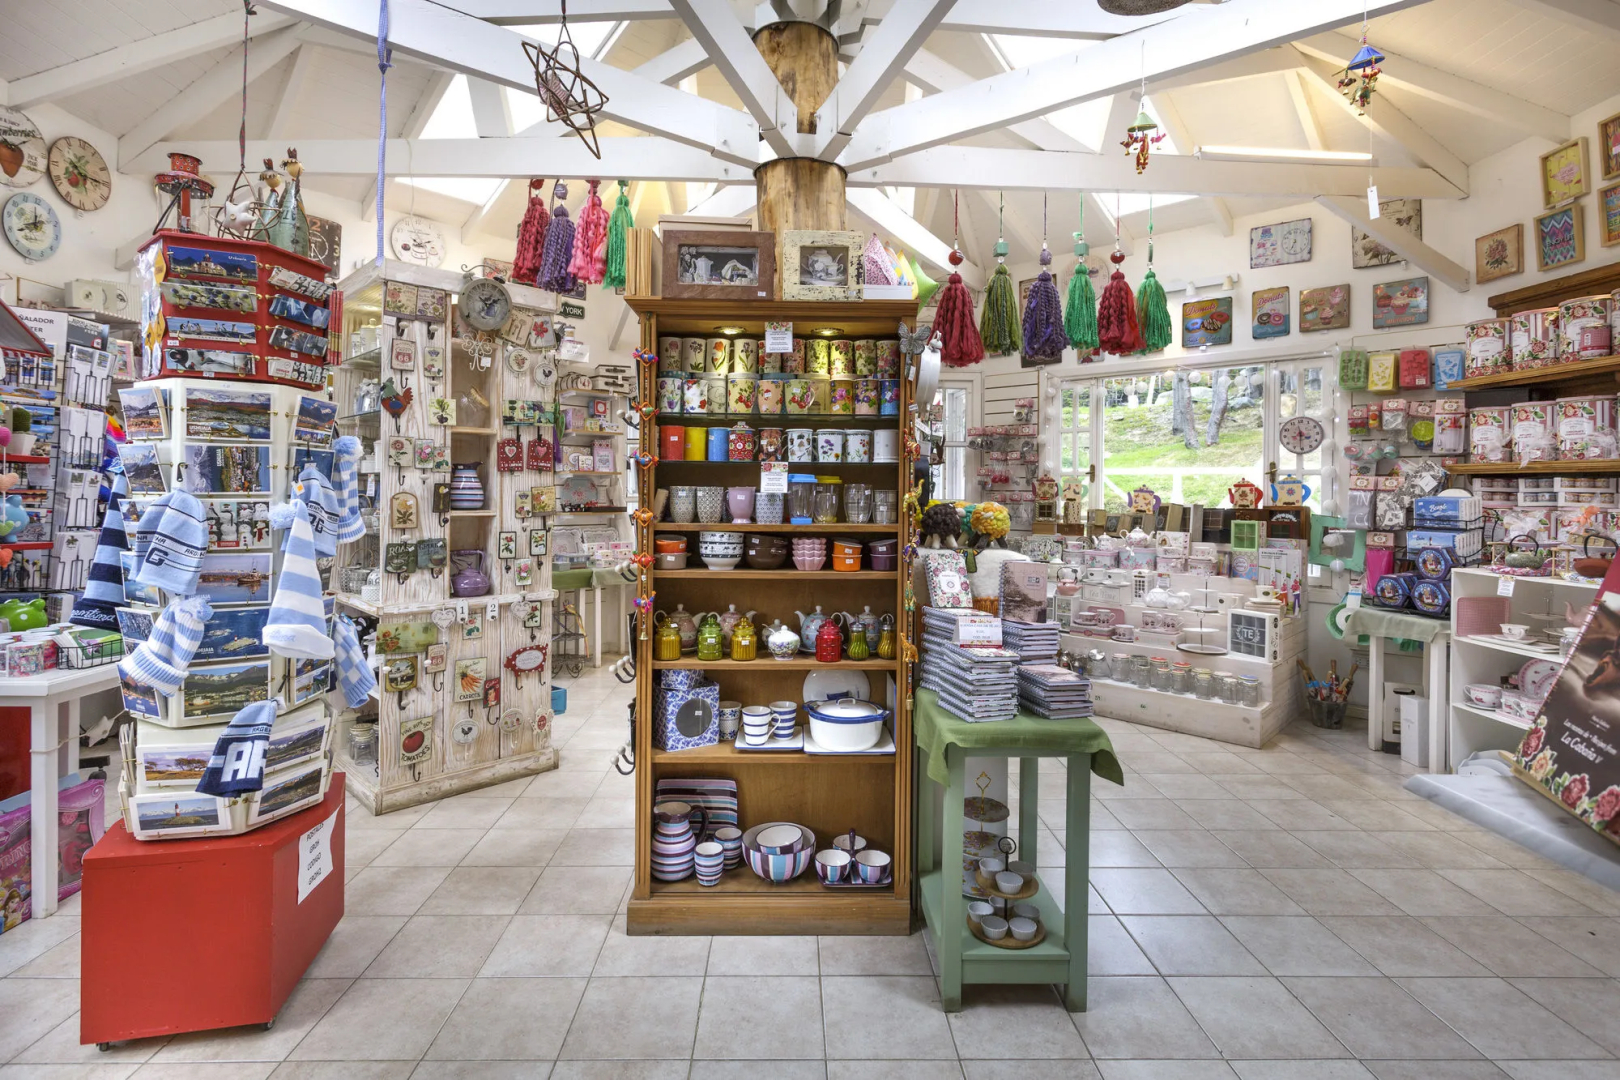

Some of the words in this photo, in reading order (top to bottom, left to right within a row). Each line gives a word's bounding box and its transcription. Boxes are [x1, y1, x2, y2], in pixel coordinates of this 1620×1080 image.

[565, 305, 583, 316] YORK
[1185, 302, 1216, 317] Donuts
[397, 354, 410, 362] 66
[460, 606, 465, 615] 1
[490, 604, 496, 612] 2
[1242, 628, 1254, 639] TE
[1561, 731, 1572, 745] La
[1570, 737, 1597, 761] Cabaña
[401, 746, 431, 761] TOMATOES
